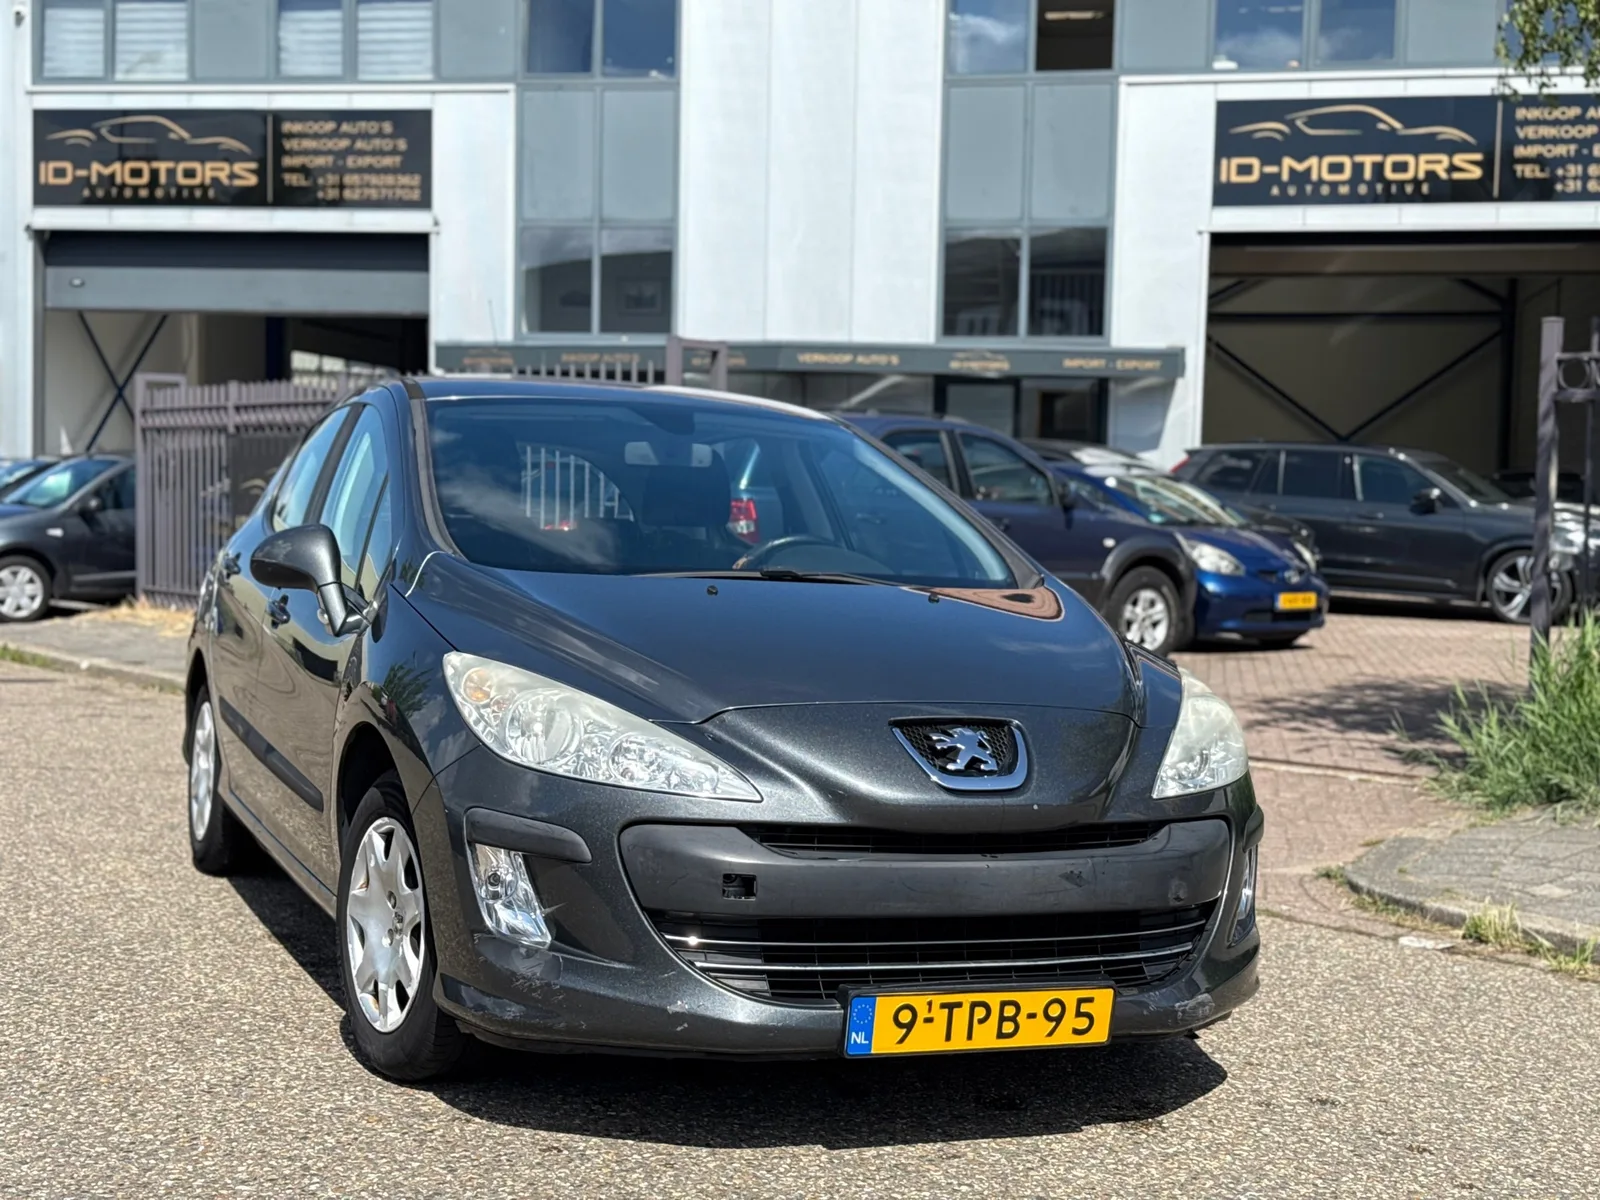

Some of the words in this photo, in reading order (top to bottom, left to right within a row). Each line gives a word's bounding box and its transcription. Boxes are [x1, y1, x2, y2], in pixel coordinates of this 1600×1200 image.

[1515, 106, 1582, 120] INKOOP
[1585, 106, 1600, 120] A
[281, 120, 337, 134] INKOOP
[339, 120, 394, 134] AUTO'S
[1515, 124, 1599, 139] VERKOOP
[281, 138, 352, 151] VERKOOP
[353, 138, 408, 151] AUTO'S
[1514, 143, 1579, 158] IMPORT
[281, 155, 335, 168] IMPORT
[346, 155, 403, 168] EXPORT
[1219, 153, 1484, 183] ID-MOTORS
[39, 161, 259, 187] ID-MOTORS
[1555, 163, 1583, 177] +31
[317, 173, 340, 186] +31
[1554, 178, 1582, 193] +31
[82, 186, 216, 198] AUTOMOTIVE
[317, 187, 340, 200] +31
[1270, 182, 1431, 196] AUTOMOTIVE
[851, 1031, 869, 1045] NL
